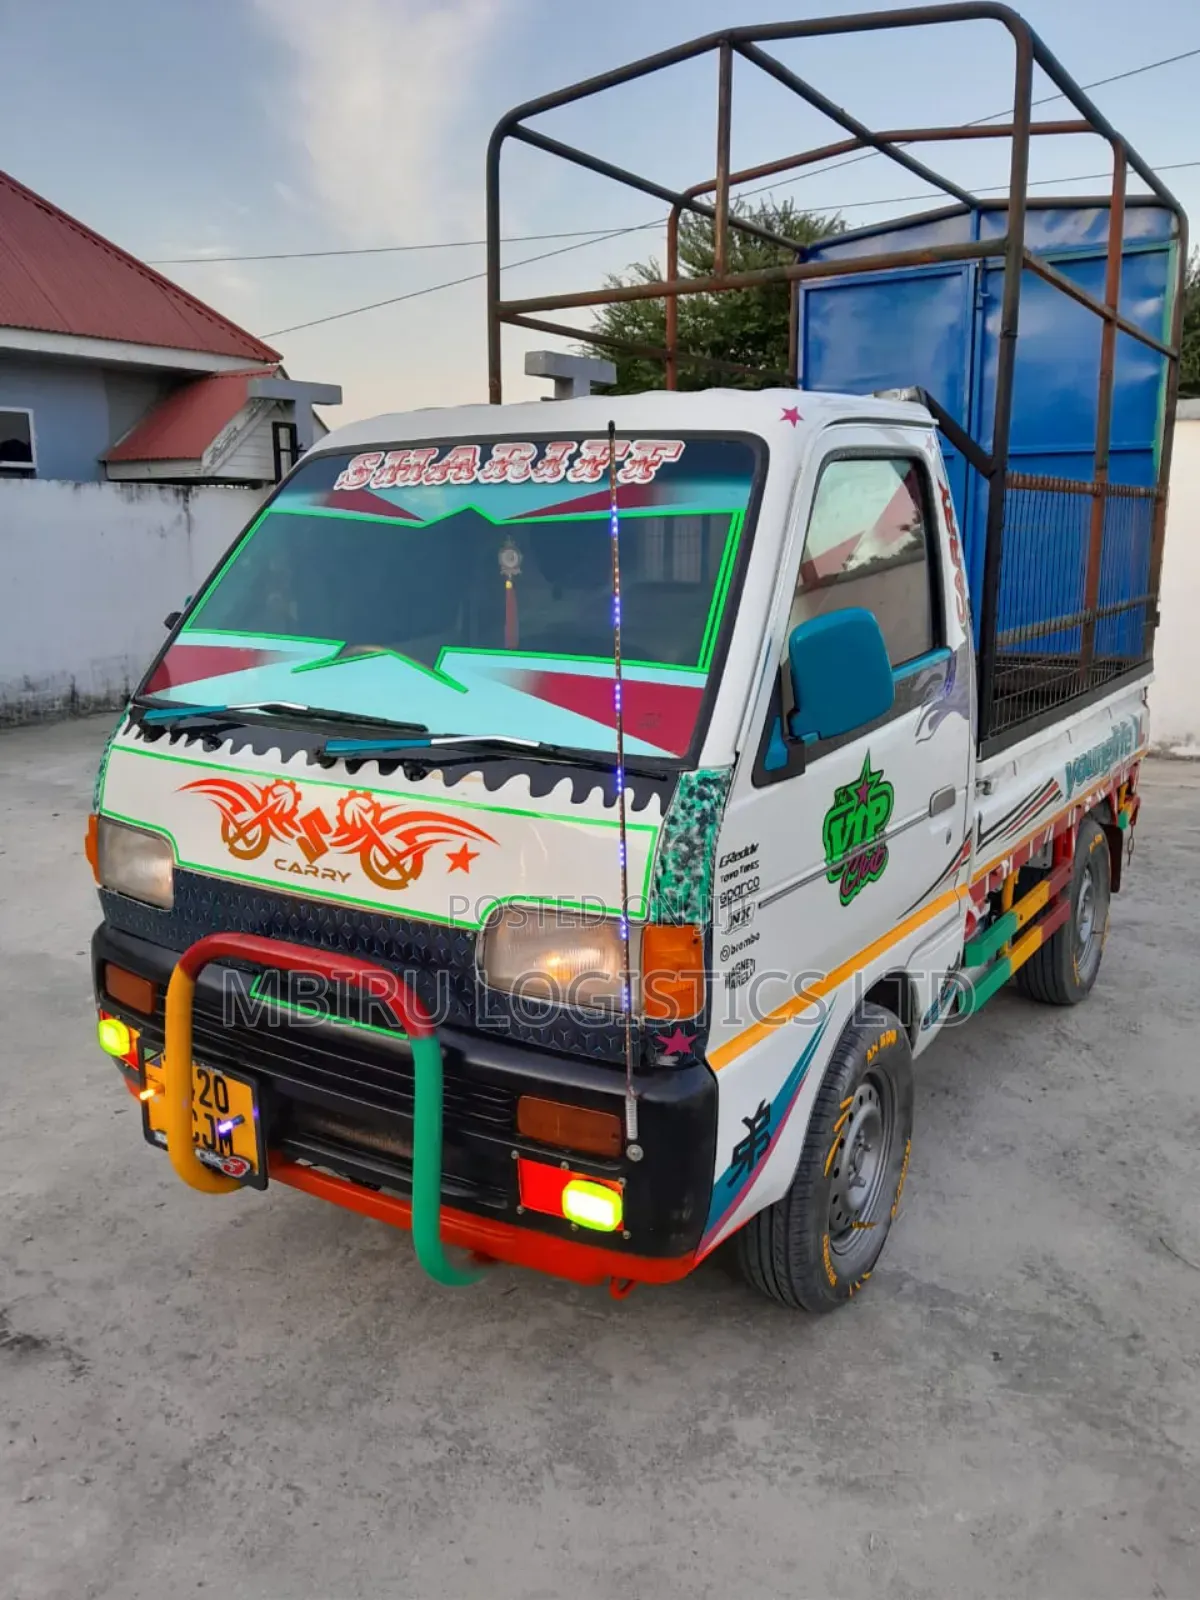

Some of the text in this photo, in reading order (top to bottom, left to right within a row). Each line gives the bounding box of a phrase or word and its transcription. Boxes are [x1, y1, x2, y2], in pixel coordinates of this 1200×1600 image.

[334, 439, 685, 491] SHARIFF
[826, 790, 892, 864] VIP
[274, 858, 352, 884] CARRY
[192, 1068, 230, 1113] 20
